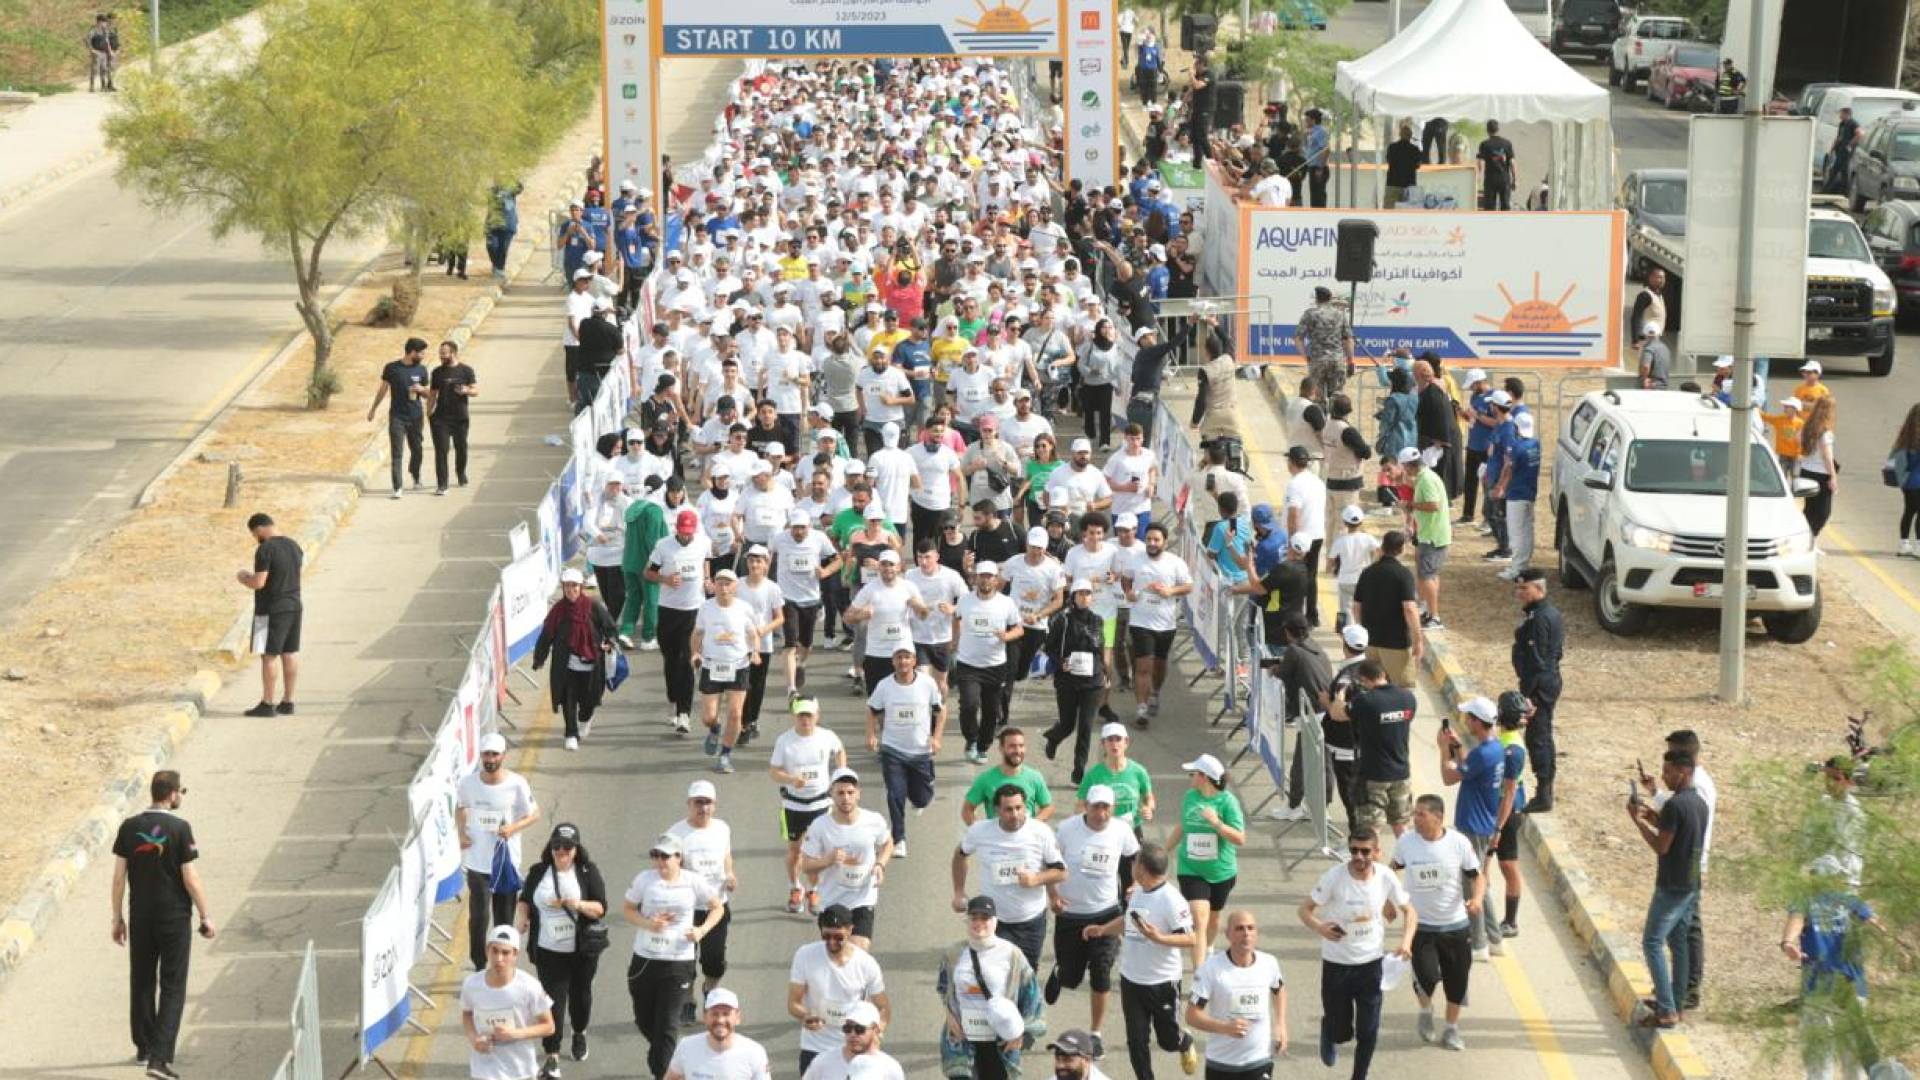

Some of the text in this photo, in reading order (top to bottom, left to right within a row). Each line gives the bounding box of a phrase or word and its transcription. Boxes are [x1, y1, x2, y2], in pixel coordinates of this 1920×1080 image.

[835, 11, 887, 22] 12/5/2023
[677, 29, 842, 50] START 10 KM
[1256, 226, 1338, 252] AQUAFIN
[1364, 338, 1395, 348] POINT
[1398, 338, 1413, 348] ON
[1416, 338, 1449, 349] EARTH
[1239, 993, 1260, 1006] 620
